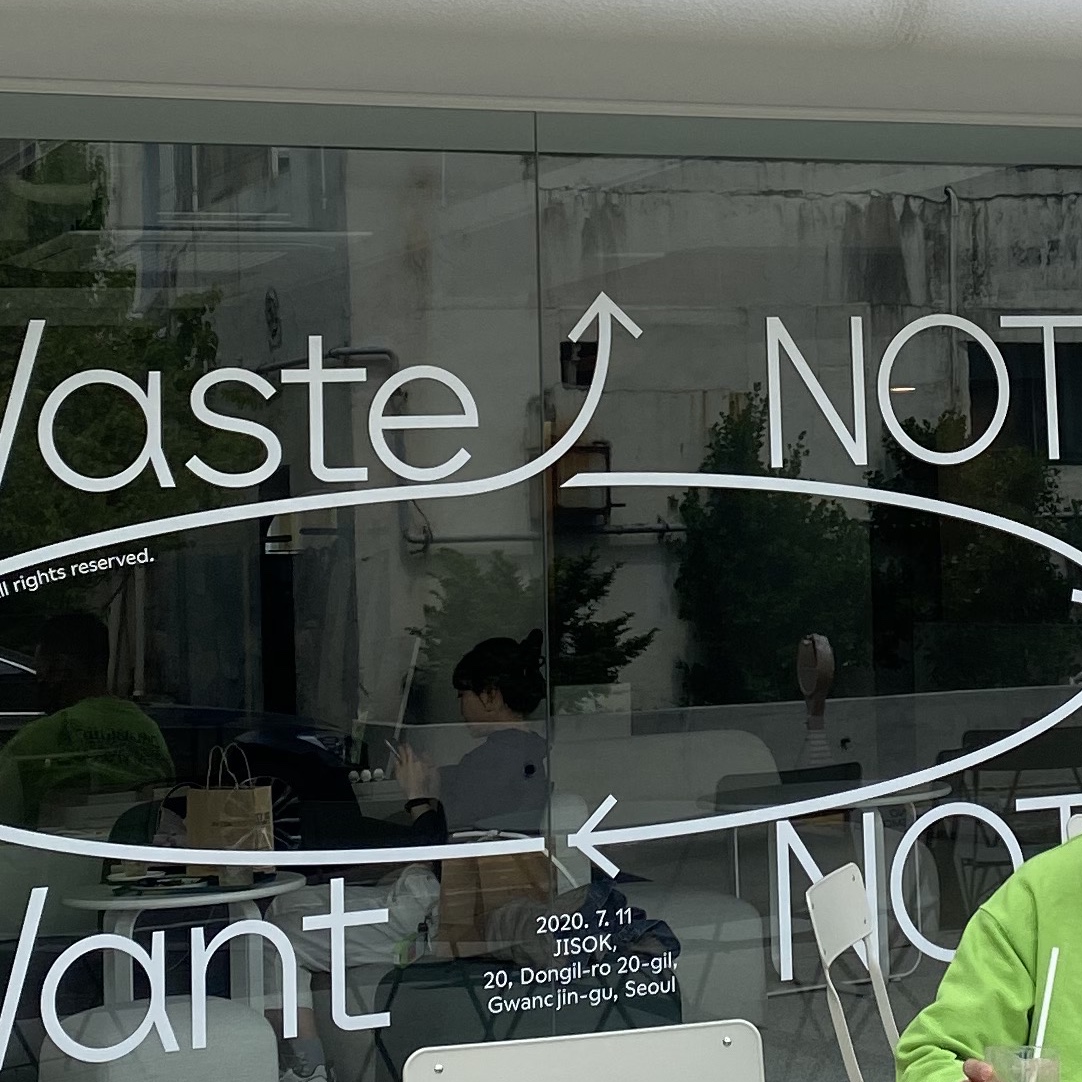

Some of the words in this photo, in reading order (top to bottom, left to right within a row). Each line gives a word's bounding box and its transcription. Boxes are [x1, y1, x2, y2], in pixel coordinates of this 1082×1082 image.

[12, 568, 67, 592] rights
[70, 547, 155, 577] reserved.
[536, 912, 589, 934] 2020.
[595, 909, 610, 928] 7.
[615, 907, 632, 925] 11
[553, 934, 617, 957] JISOK,
[483, 970, 513, 990] 20,
[520, 962, 611, 985] Dongil-ro
[617, 952, 678, 975] 20-gil,
[625, 976, 676, 998] Seoul
